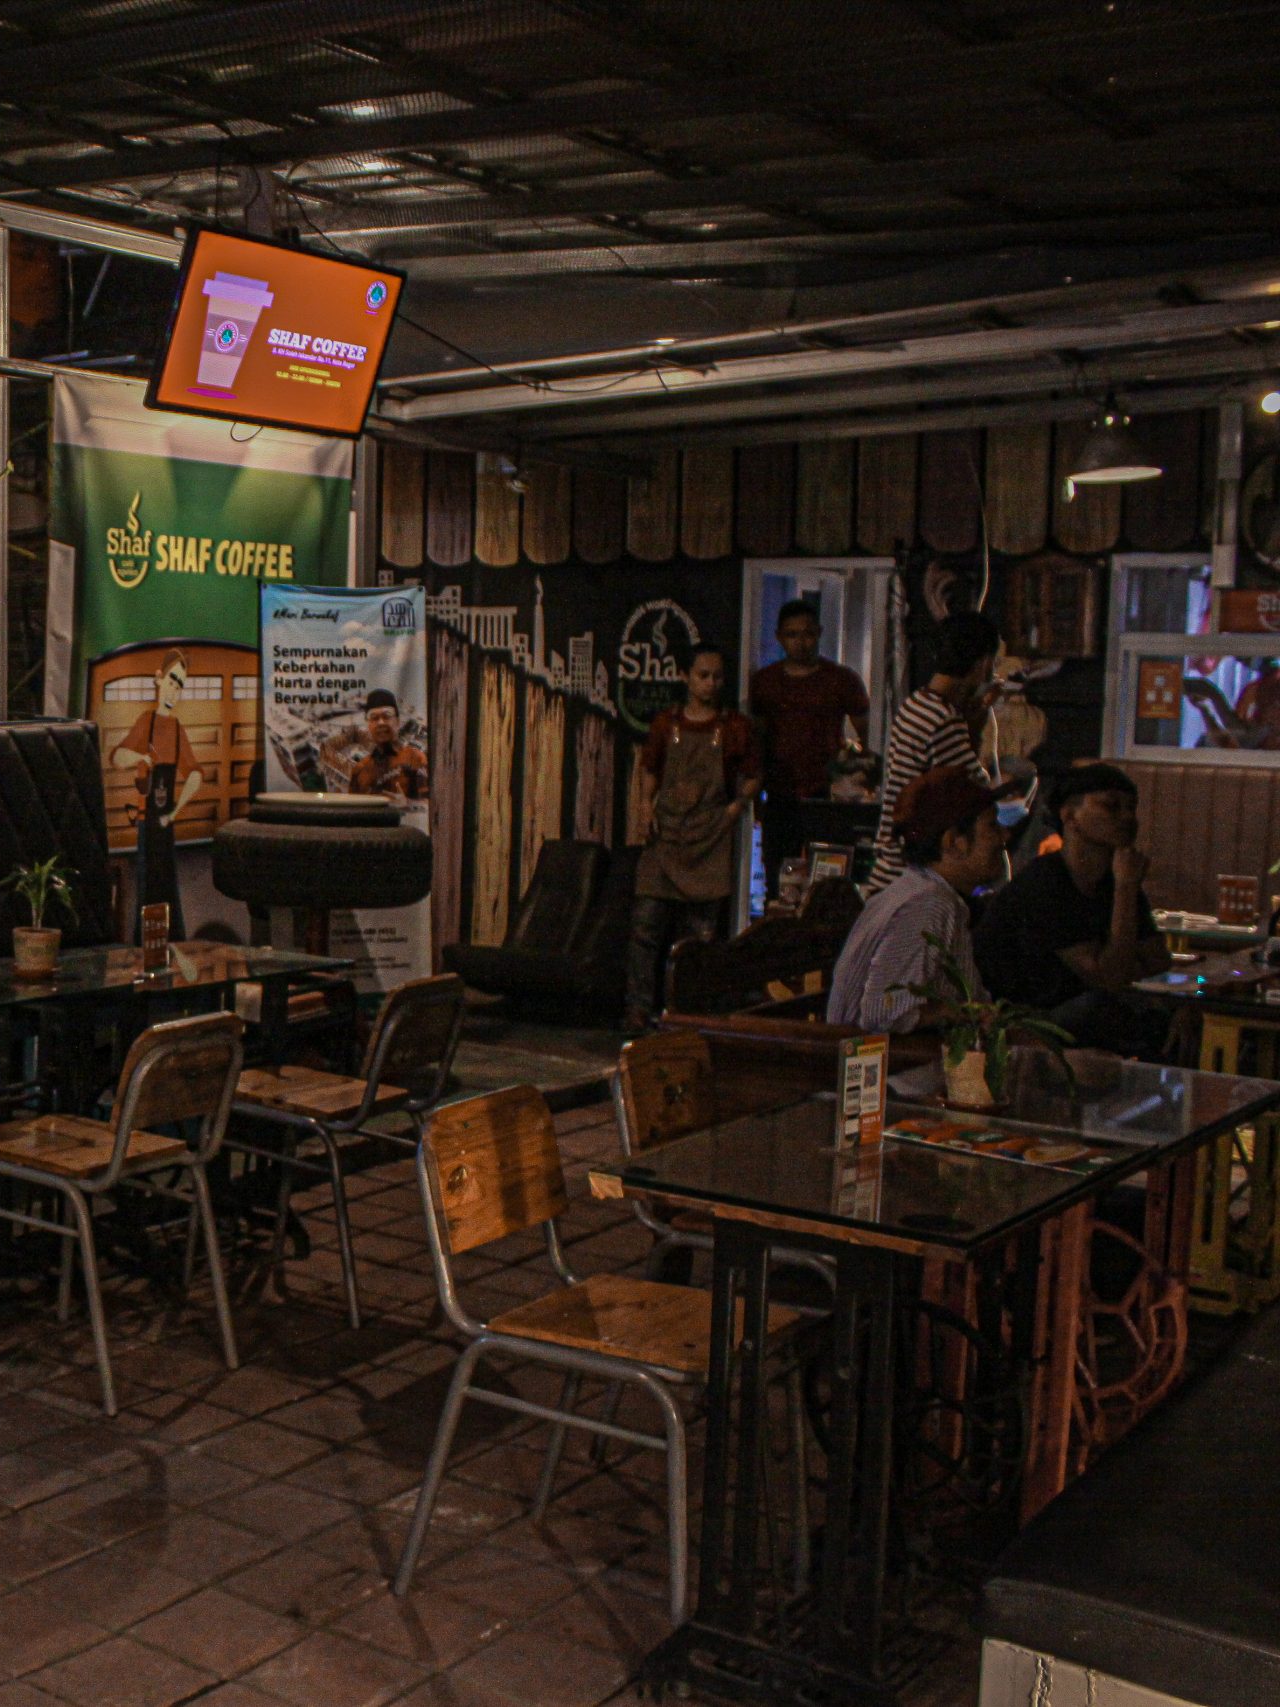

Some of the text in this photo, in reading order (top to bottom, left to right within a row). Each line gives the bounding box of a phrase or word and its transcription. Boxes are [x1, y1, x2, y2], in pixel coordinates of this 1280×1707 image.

[268, 328, 312, 351] SHAF
[312, 336, 367, 362] COFFEE
[107, 527, 152, 557] Shaf
[155, 534, 294, 578] SHAF COFFEE
[273, 645, 368, 659] Sempurnakan
[618, 641, 688, 682] Sha
[274, 661, 355, 674] Keberkahan
[274, 677, 366, 691] Harta dengan
[274, 692, 339, 705] Berwakaf
